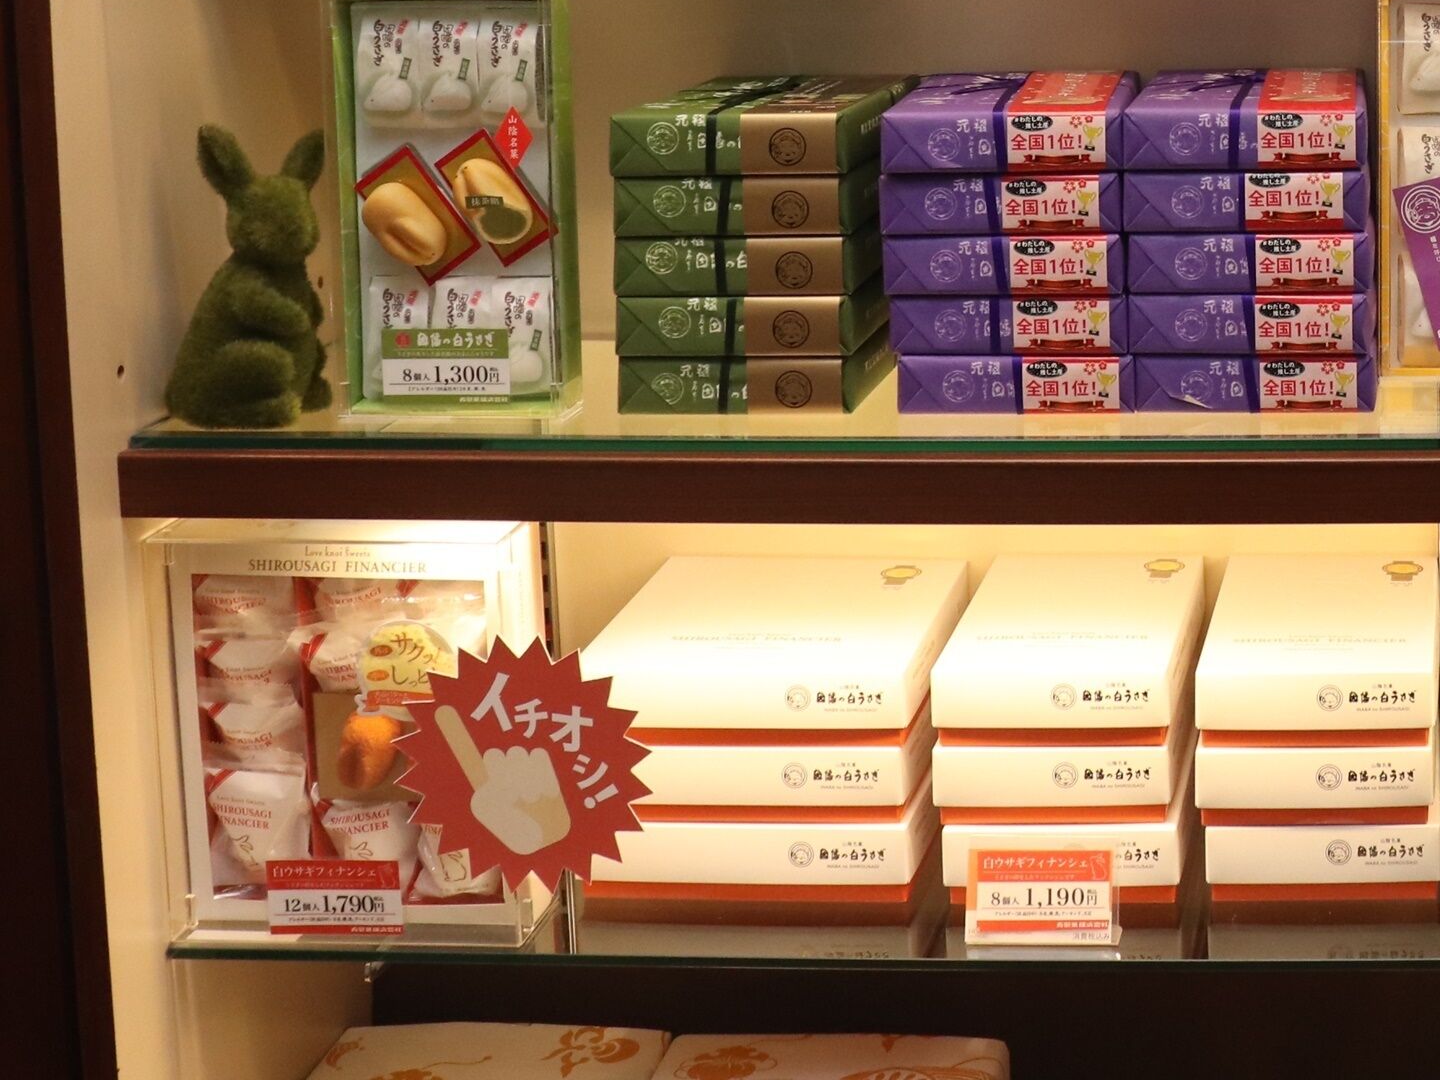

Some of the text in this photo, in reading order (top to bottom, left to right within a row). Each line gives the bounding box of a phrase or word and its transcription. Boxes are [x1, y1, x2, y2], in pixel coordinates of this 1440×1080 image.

[507, 115, 520, 160] 山陰名菓
[249, 560, 426, 573] SHIROUSAGI FINANCIER
[221, 816, 269, 830] INANCIER
[983, 857, 1088, 869] 白ウサギフィナンシェ
